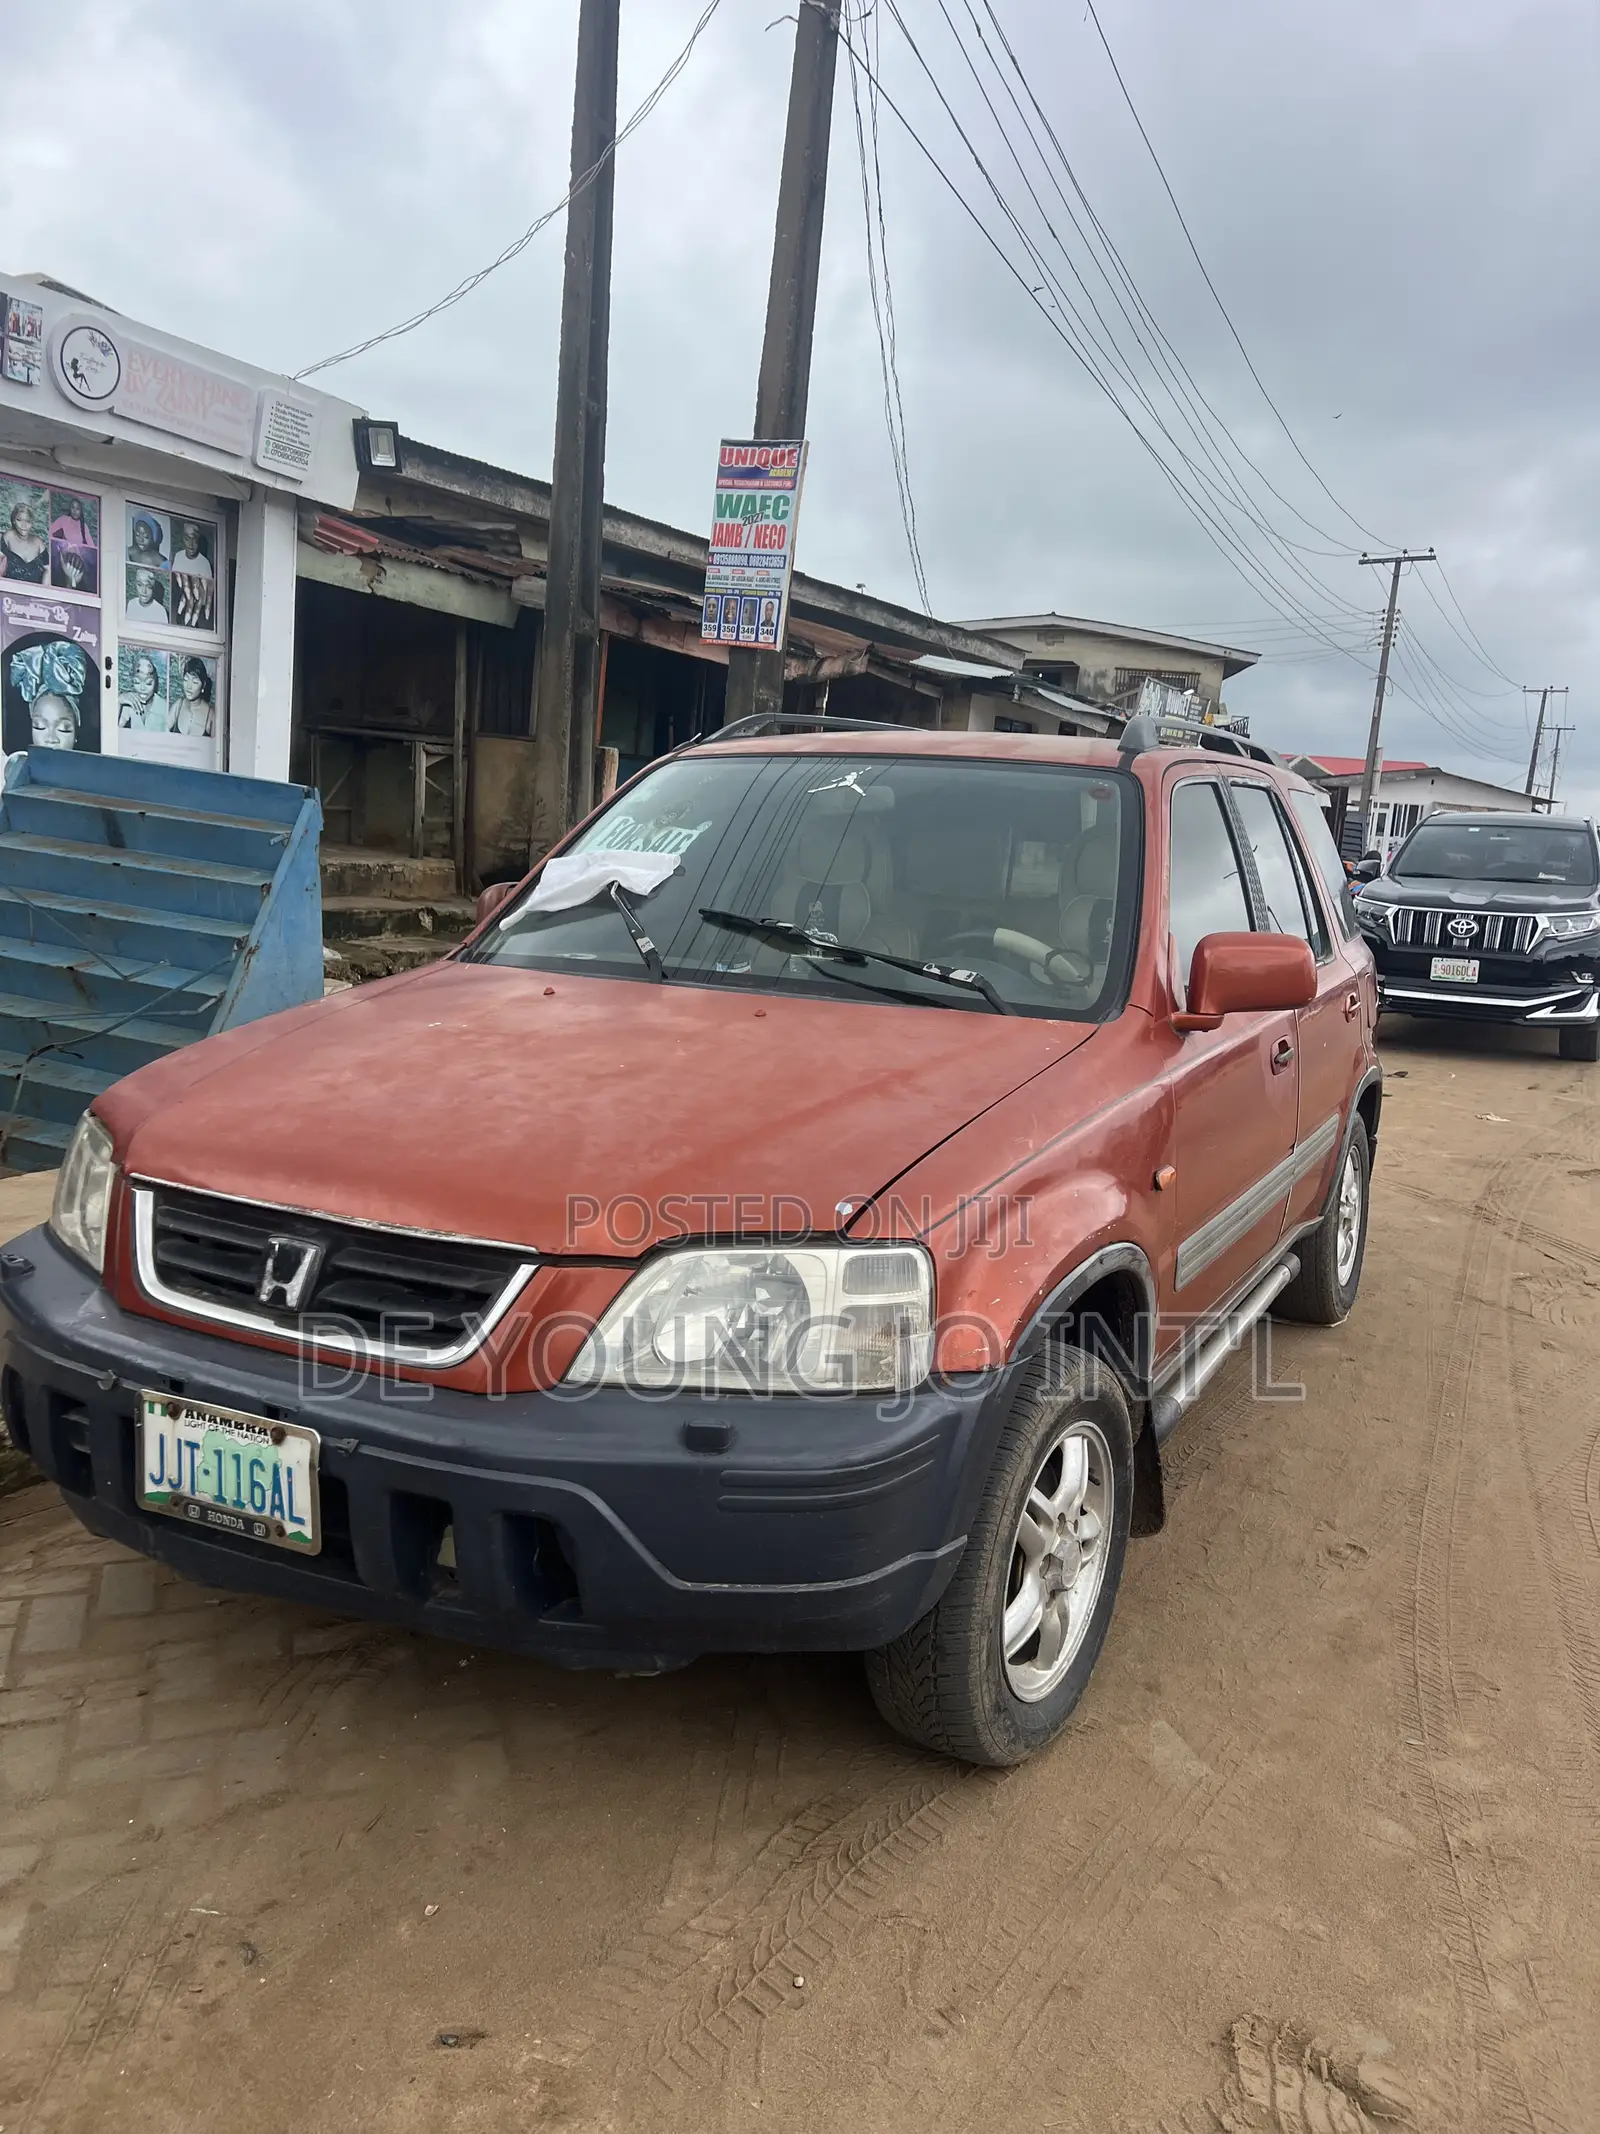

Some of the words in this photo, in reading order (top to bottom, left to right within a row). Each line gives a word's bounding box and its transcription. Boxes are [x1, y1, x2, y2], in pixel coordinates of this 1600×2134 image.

[719, 446, 799, 470] UNIQUE
[769, 469, 796, 477] ACADEMY
[716, 493, 791, 520] WAEC
[711, 522, 744, 548] JAMB
[753, 523, 787, 550] NECO
[703, 624, 717, 632] 359
[760, 628, 774, 636] 340
[183, 1418, 206, 1431] LIGHT
[207, 1423, 220, 1433] OF
[221, 1425, 236, 1438] THE
[236, 1430, 270, 1445] NATION
[184, 1408, 270, 1437] ANAMBRA
[207, 1510, 245, 1531] HONDA
